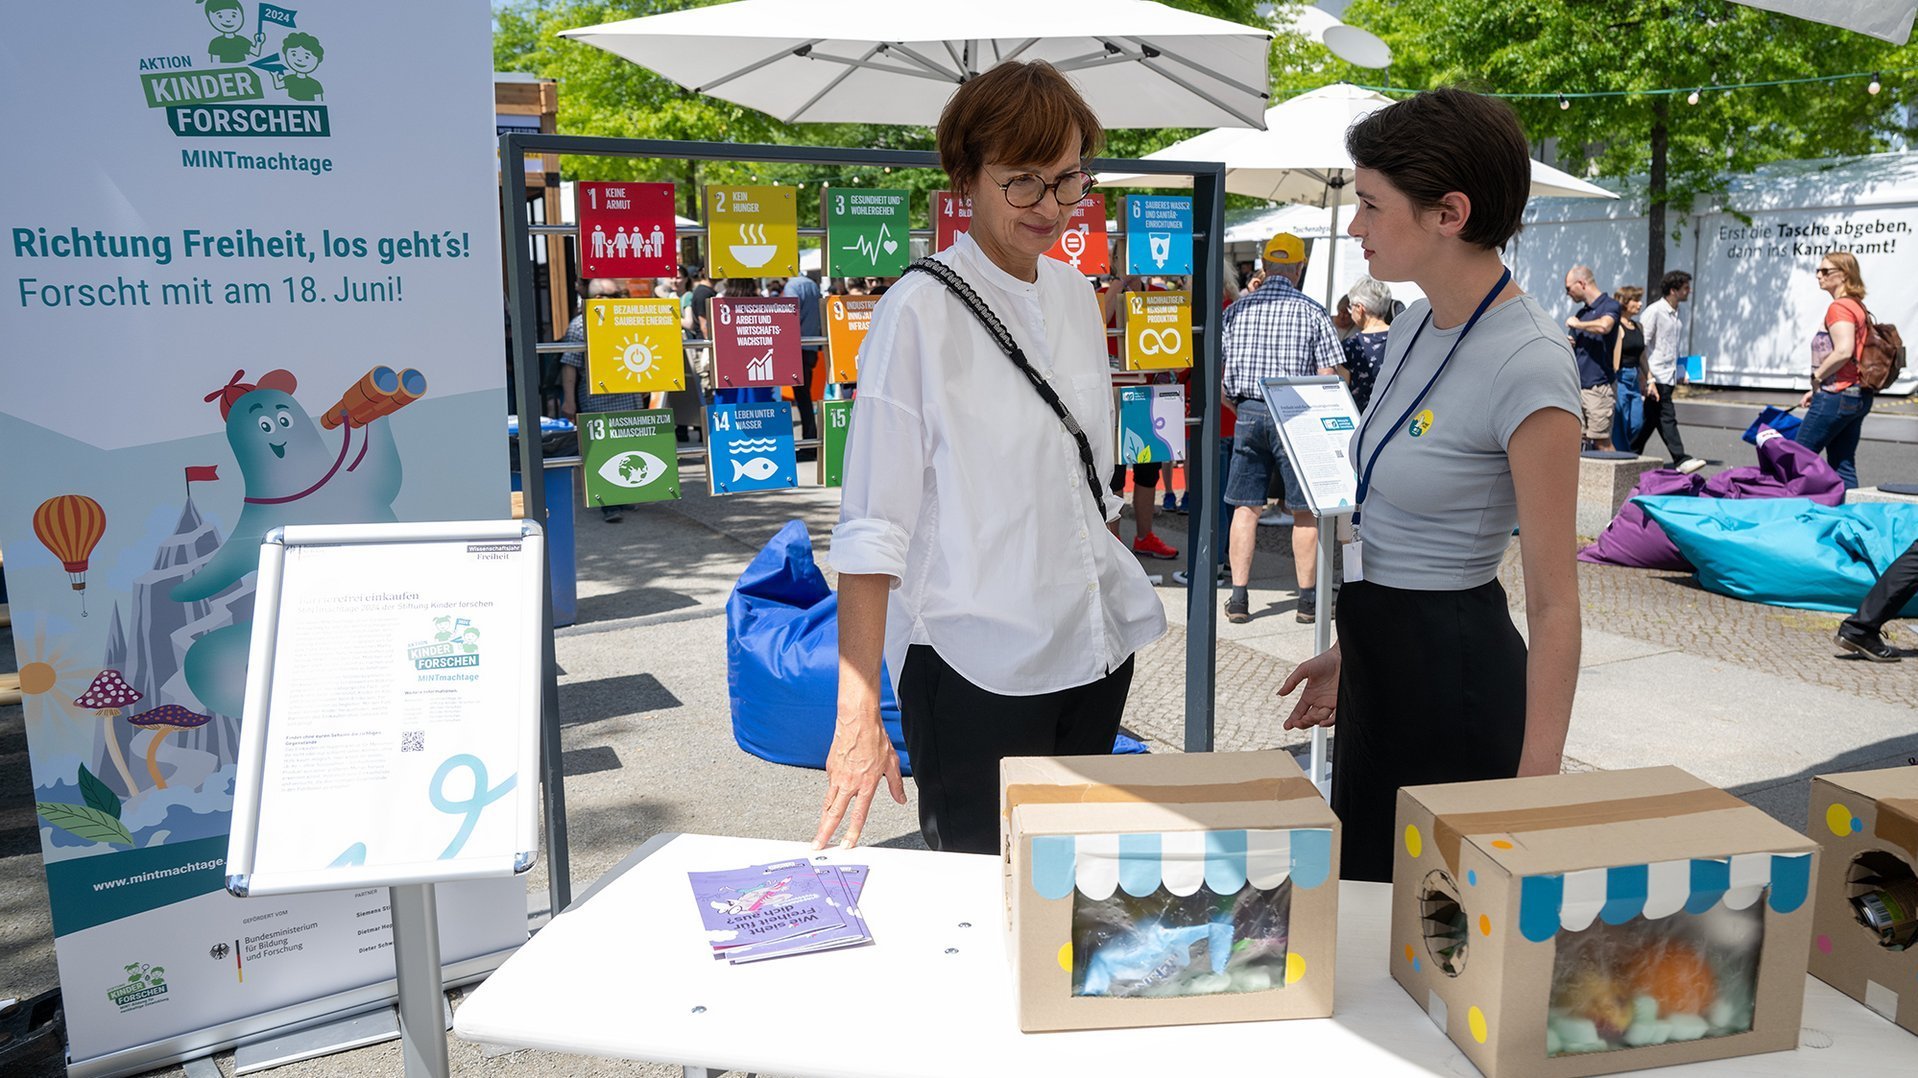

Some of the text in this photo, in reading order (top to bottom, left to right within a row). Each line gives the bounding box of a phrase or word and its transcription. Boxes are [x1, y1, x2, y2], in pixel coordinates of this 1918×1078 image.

[264, 7, 291, 23] 2024
[139, 55, 192, 70] AKTION
[150, 72, 256, 103] KINDER
[176, 107, 323, 134] FORSCHEN
[181, 149, 334, 176] MINTmachtage
[590, 188, 597, 211] 1
[605, 188, 626, 199] KEINE
[732, 191, 748, 201] KEIN
[850, 195, 901, 205] GESUNDHEIT UND
[606, 200, 631, 211] ARMUT
[716, 191, 726, 213] 2
[732, 203, 760, 213] HUNGER
[835, 195, 845, 216] 3
[944, 198, 953, 217] 4
[1133, 200, 1141, 219] 6
[1145, 200, 1190, 210] SAUBERES WASSER
[850, 206, 895, 216] WOHLERGEHEN
[1145, 210, 1178, 219] UND SANITÄR-
[1145, 219, 1183, 229] EINRICHTUNGEN
[1719, 219, 1913, 240] Erst die Tasche abgeben,
[12, 227, 173, 265] Richtung
[183, 229, 316, 263] Freiheit,
[324, 230, 368, 258] los
[1727, 239, 1896, 259] dann ins Kanzleramt!
[19, 276, 403, 307] Forscht mit am 18. Juni!
[613, 304, 672, 315] BEZAHLBARE UND
[834, 301, 844, 320] 9
[1131, 296, 1143, 315] 12
[1147, 305, 1178, 314] KONSUM UND
[596, 305, 605, 326] 7
[614, 315, 673, 326] SAUBERE ENERGIE
[720, 304, 731, 325] 8
[736, 315, 772, 325] ARBEIT UND
[1147, 314, 1178, 323] PRODUKTION
[736, 325, 781, 335] WIRTSCHAFTS-
[737, 336, 773, 346] WACHSTUM
[609, 414, 671, 427] MASSNAHMEN ZUM
[734, 408, 775, 419] LEBEN UNTER
[830, 408, 846, 428] 15
[713, 411, 730, 432] 14
[735, 420, 762, 430] WASSER
[587, 418, 605, 441] 13
[610, 426, 656, 439] KLIMASCHUTZ
[468, 544, 521, 552] Wissenschaftsjahr
[477, 552, 509, 561] Freiheit
[365, 590, 420, 604] einkaufen
[360, 603, 381, 613] 2024
[382, 603, 396, 612] der
[397, 601, 429, 613] Stiftung
[430, 599, 457, 610] Kinder
[458, 598, 494, 610] forschen
[410, 644, 451, 660] KINDER
[418, 655, 476, 669] FORSCHEN
[418, 673, 479, 682] MINTmachtage
[93, 856, 227, 892] www.mintmachtage.
[355, 889, 377, 898] PARTNER
[242, 909, 288, 924] GEFÖRDERT VOM
[356, 908, 381, 918] Siemens
[727, 904, 795, 925] dich aus?
[734, 907, 816, 931] Freiheit für
[357, 926, 380, 936] Dietmar
[749, 914, 819, 936] Wie sieht
[245, 922, 318, 945] Bundesministerium
[245, 938, 289, 953] für Bildung
[246, 943, 304, 962] und Forschung
[358, 945, 377, 954] Dieter
[110, 982, 143, 999] KINDER
[118, 985, 166, 1005] FORSCHEN
